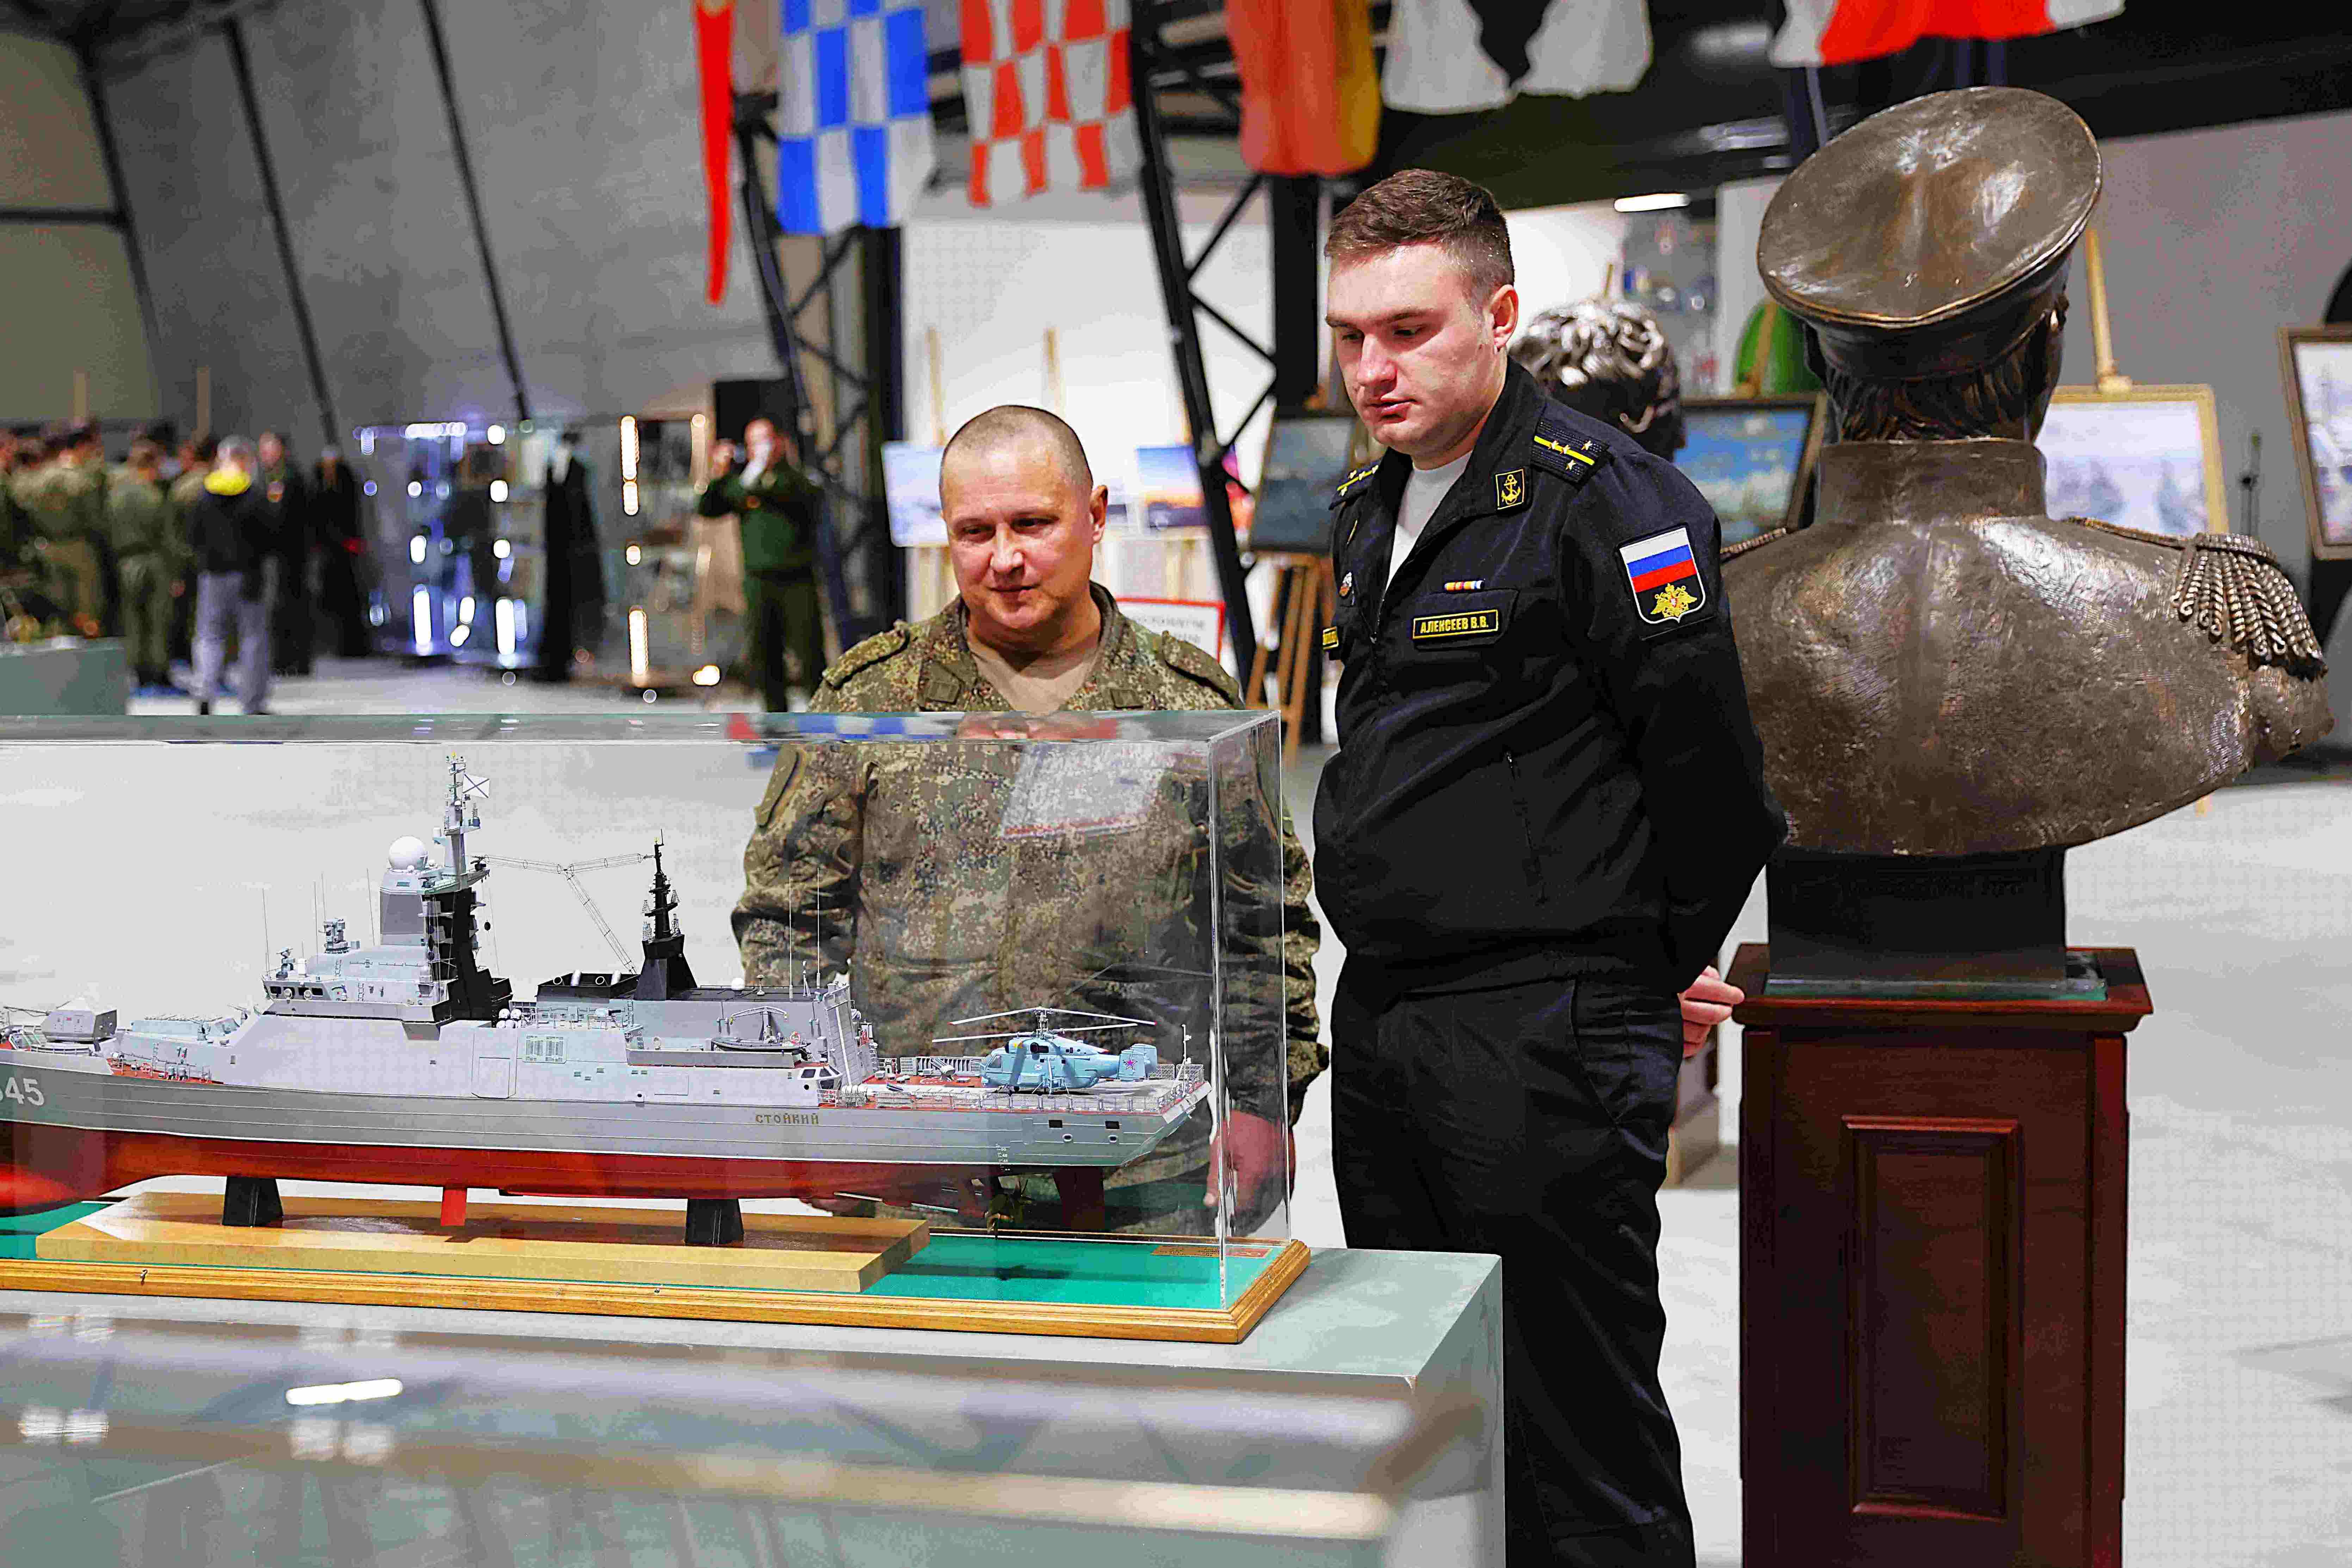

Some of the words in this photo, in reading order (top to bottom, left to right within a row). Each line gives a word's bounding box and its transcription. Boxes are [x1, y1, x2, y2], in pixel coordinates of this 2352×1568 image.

[1420, 618, 1468, 633] АЛЕКСЕЕВ
[1471, 616, 1488, 628] В.В.
[0, 1077, 44, 1106] 45
[755, 1113, 819, 1124] СТОЙКИЙ
